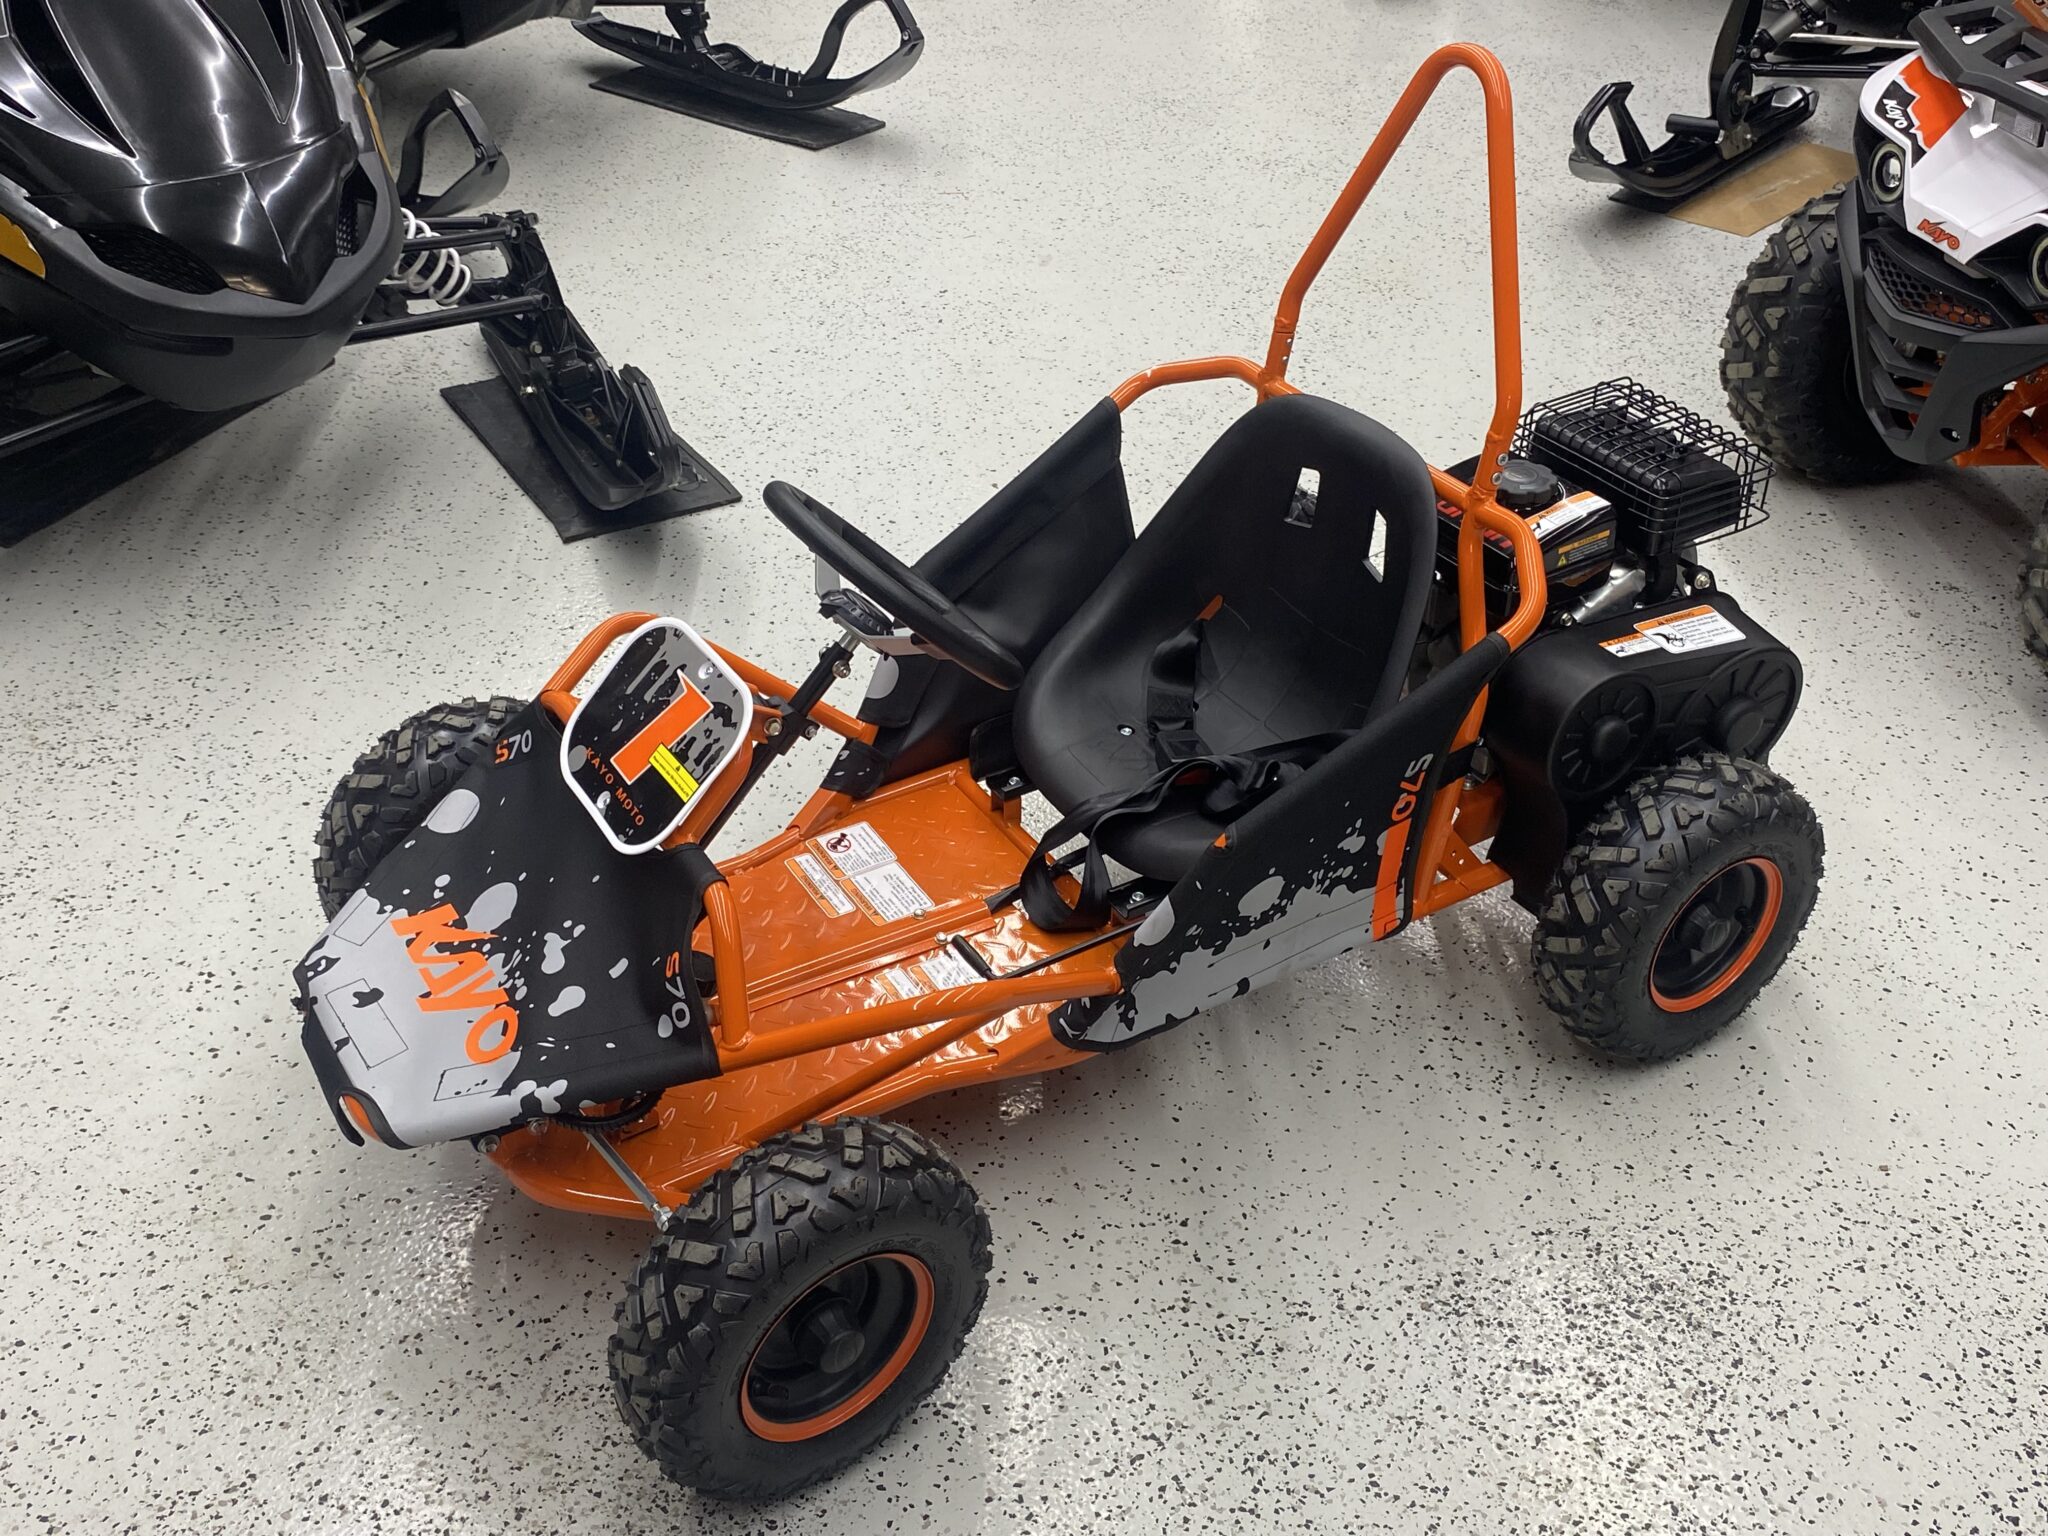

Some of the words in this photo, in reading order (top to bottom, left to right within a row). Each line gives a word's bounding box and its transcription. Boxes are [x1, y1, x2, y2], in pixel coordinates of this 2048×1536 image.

[1917, 218, 1961, 250] KAYO
[494, 728, 533, 764] S70
[585, 747, 614, 785] KAYO
[615, 787, 645, 826] MOTO
[1391, 752, 1434, 822] S70
[390, 903, 519, 1064] KAYO
[665, 951, 691, 1029] S70
